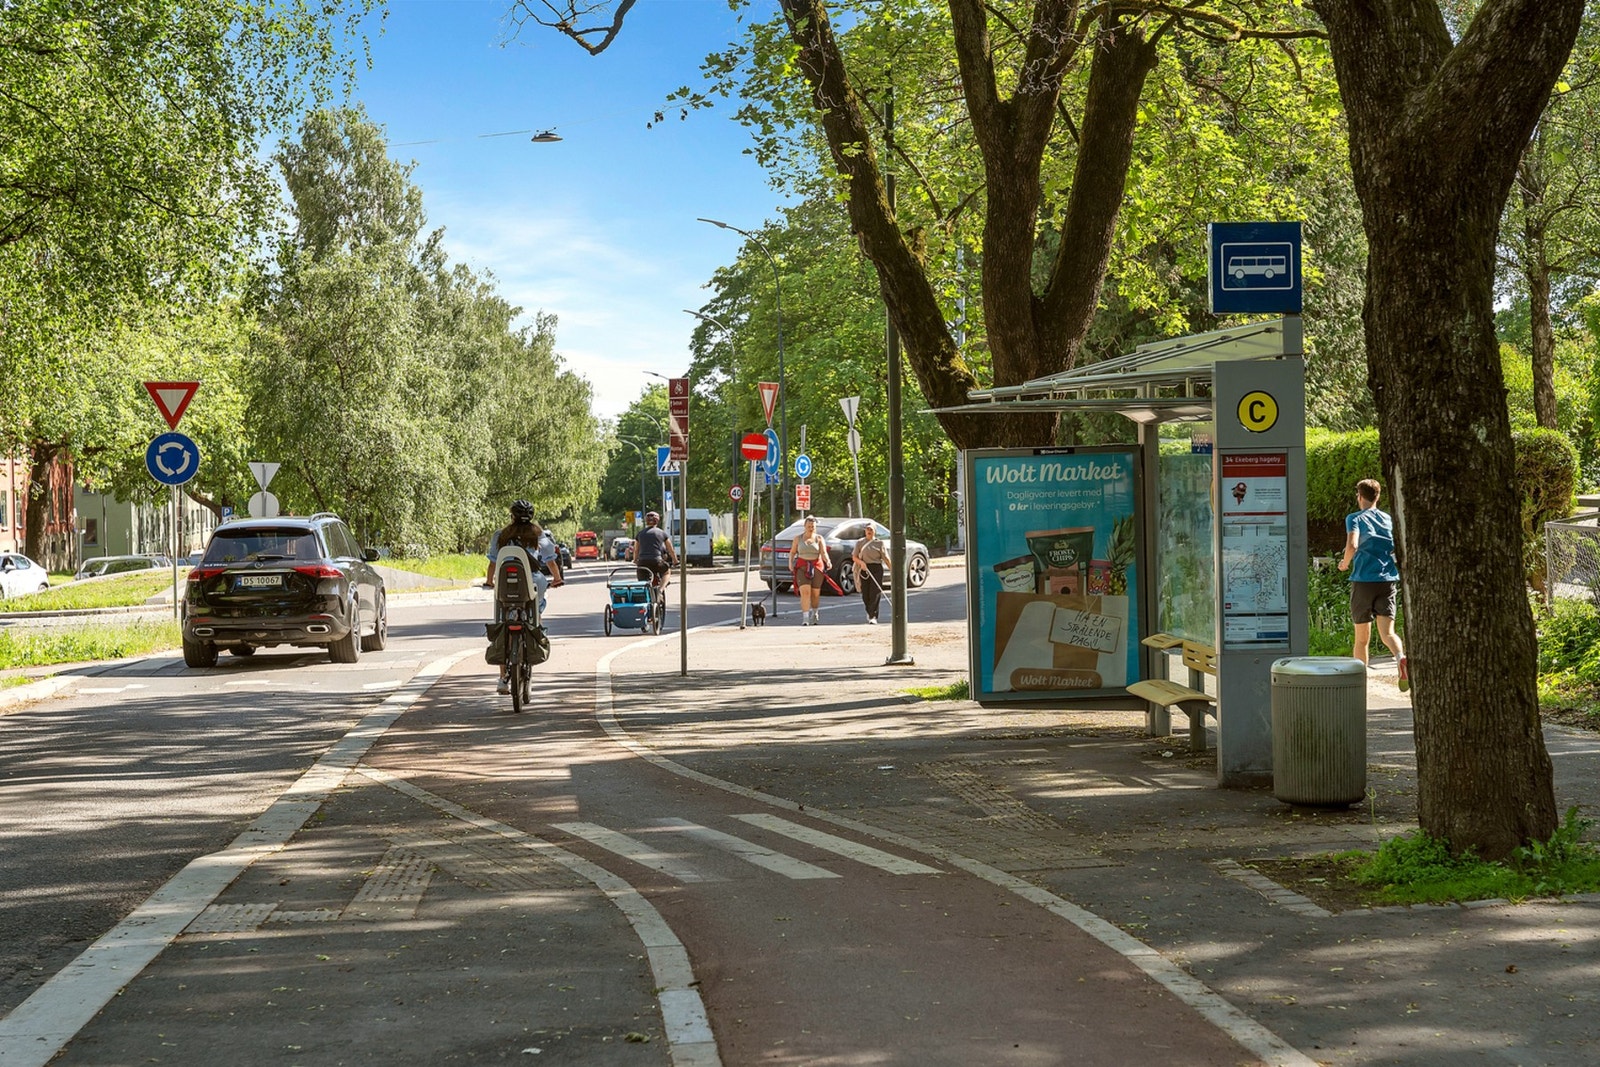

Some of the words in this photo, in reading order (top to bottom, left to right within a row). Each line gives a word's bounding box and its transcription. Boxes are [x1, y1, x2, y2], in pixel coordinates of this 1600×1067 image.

[1249, 400, 1266, 423] C
[986, 463, 1036, 484] Wolt
[1039, 461, 1121, 482] Market
[732, 489, 742, 497] 40
[1007, 490, 1056, 500] Dagligvarer
[1057, 489, 1081, 498] levert
[1083, 488, 1102, 497] med
[224, 507, 230, 516] P
[1017, 502, 1029, 511] kr
[243, 577, 254, 585] DS
[257, 576, 280, 584] 10067
[1092, 616, 1108, 627] EN
[1020, 674, 1048, 686] Wolt
[1049, 675, 1093, 687] Market
